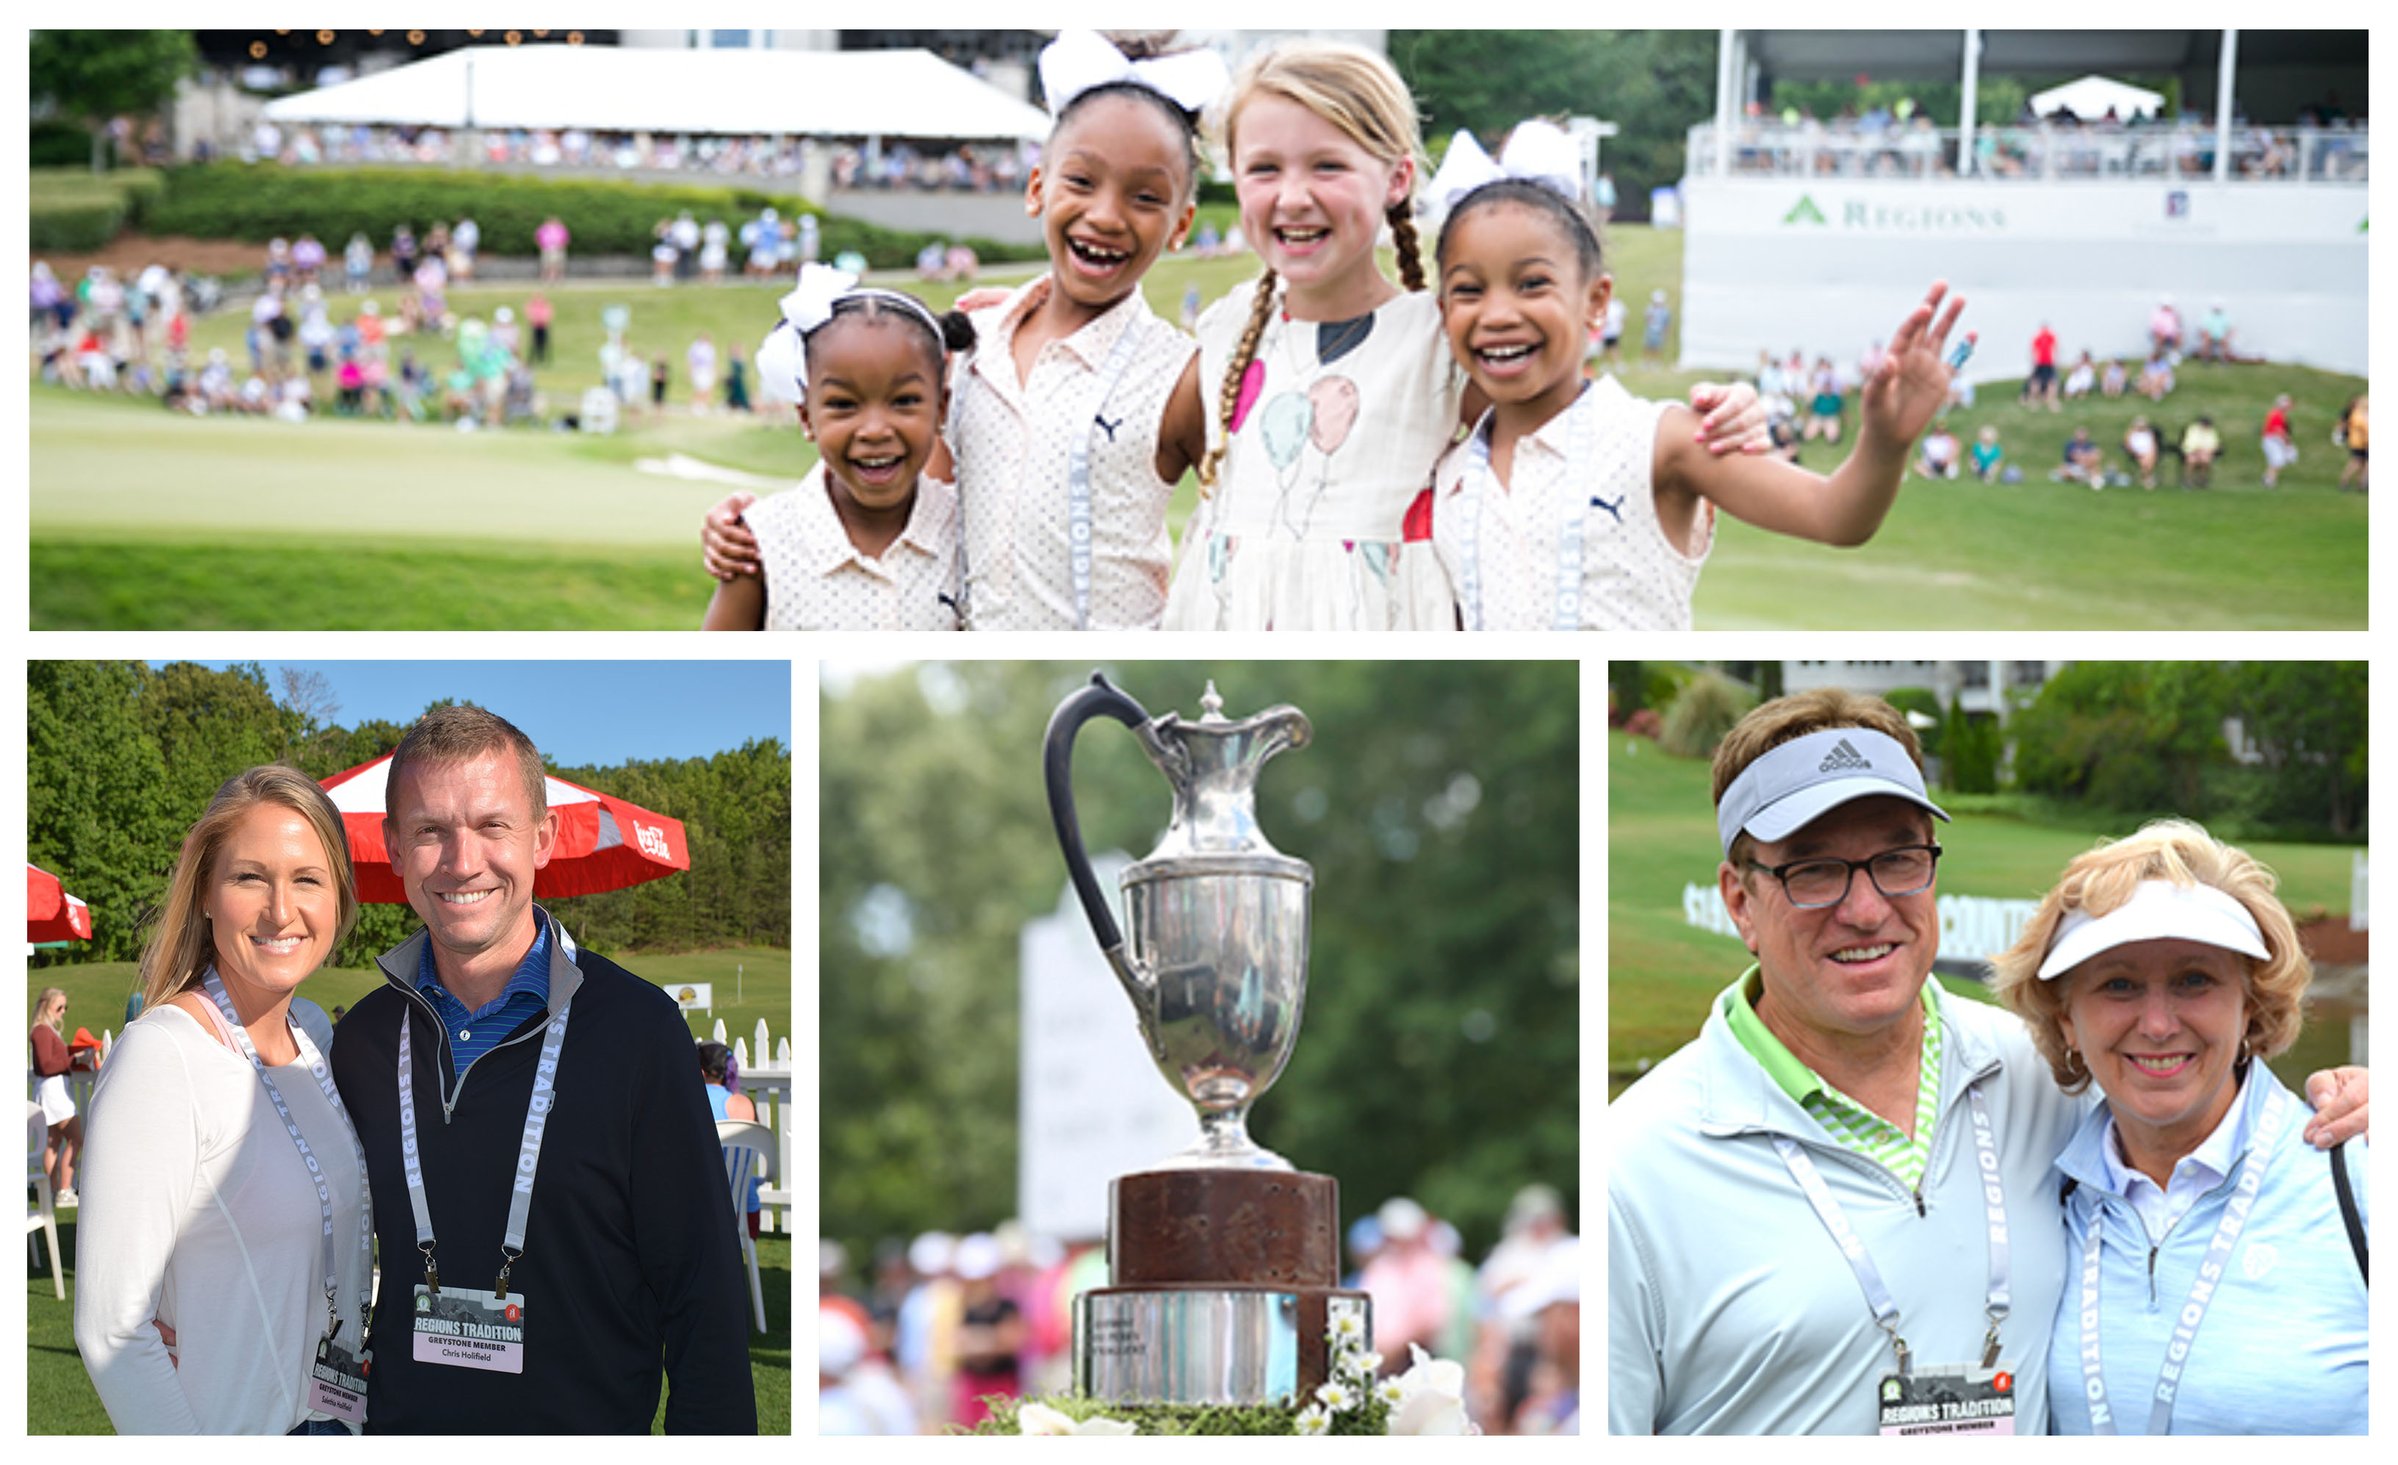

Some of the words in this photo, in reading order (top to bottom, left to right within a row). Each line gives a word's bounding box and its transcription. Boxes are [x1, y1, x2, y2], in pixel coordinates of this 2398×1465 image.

[1818, 757, 1872, 773] adidas
[400, 1076, 422, 1189] REGIONS
[515, 1044, 561, 1194] TRADITION
[287, 1123, 334, 1236] REGIONS
[1972, 1110, 2008, 1244] REGIONS
[2156, 1261, 2221, 1404] REGIONS
[2211, 1088, 2287, 1255] TRADITION
[415, 1317, 460, 1336] REGIONS
[461, 1322, 521, 1342] TRADITION
[428, 1336, 471, 1348] GREYSTONE
[472, 1341, 506, 1352] MEMBER
[2081, 1246, 2112, 1426] TRADITION
[441, 1348, 460, 1358] Chris
[461, 1351, 491, 1362] Holifield
[313, 1362, 340, 1384] REGIONS
[338, 1371, 368, 1395] TRADITION
[319, 1382, 342, 1397] GREYSTONE
[1881, 1403, 1940, 1425] REGIONS
[1941, 1397, 2015, 1420] TRADITION
[1900, 1423, 1953, 1436] GREYSTONE
